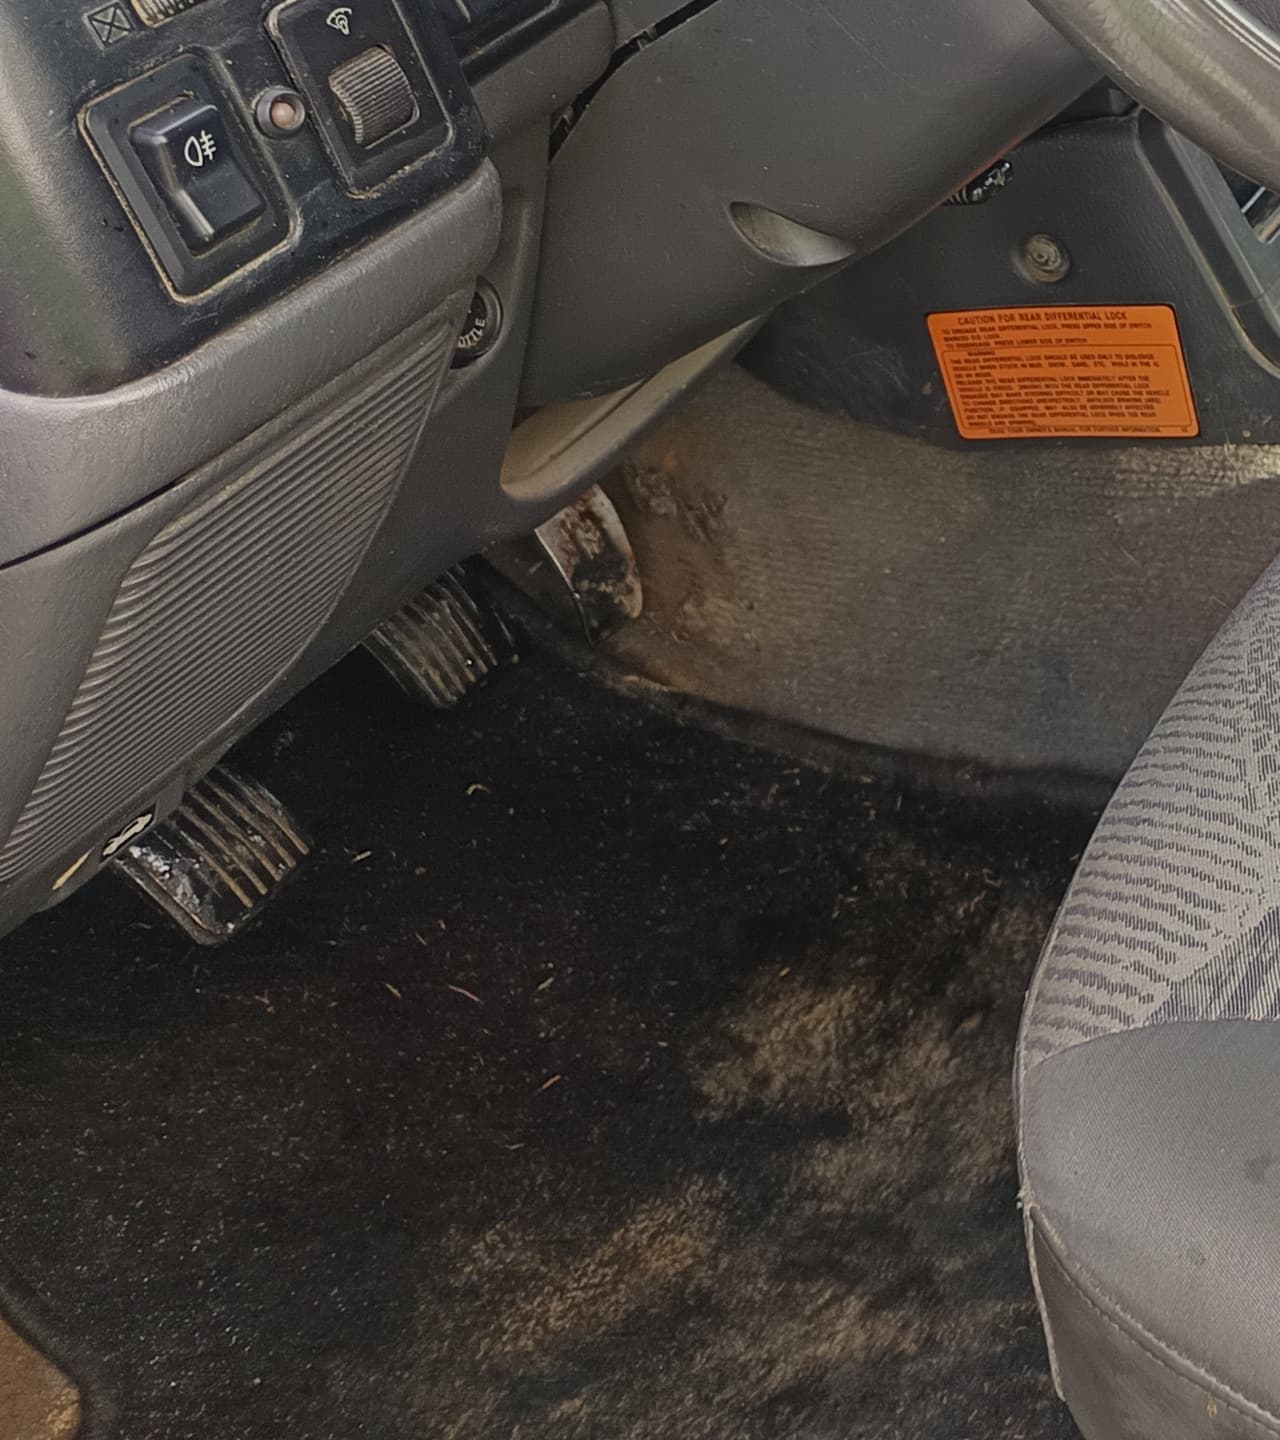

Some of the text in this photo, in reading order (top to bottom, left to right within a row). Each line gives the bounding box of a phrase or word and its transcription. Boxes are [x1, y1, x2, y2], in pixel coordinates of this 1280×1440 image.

[957, 311, 1128, 325] CAUTION FOR REAR DIFFERENTIAL LOCK
